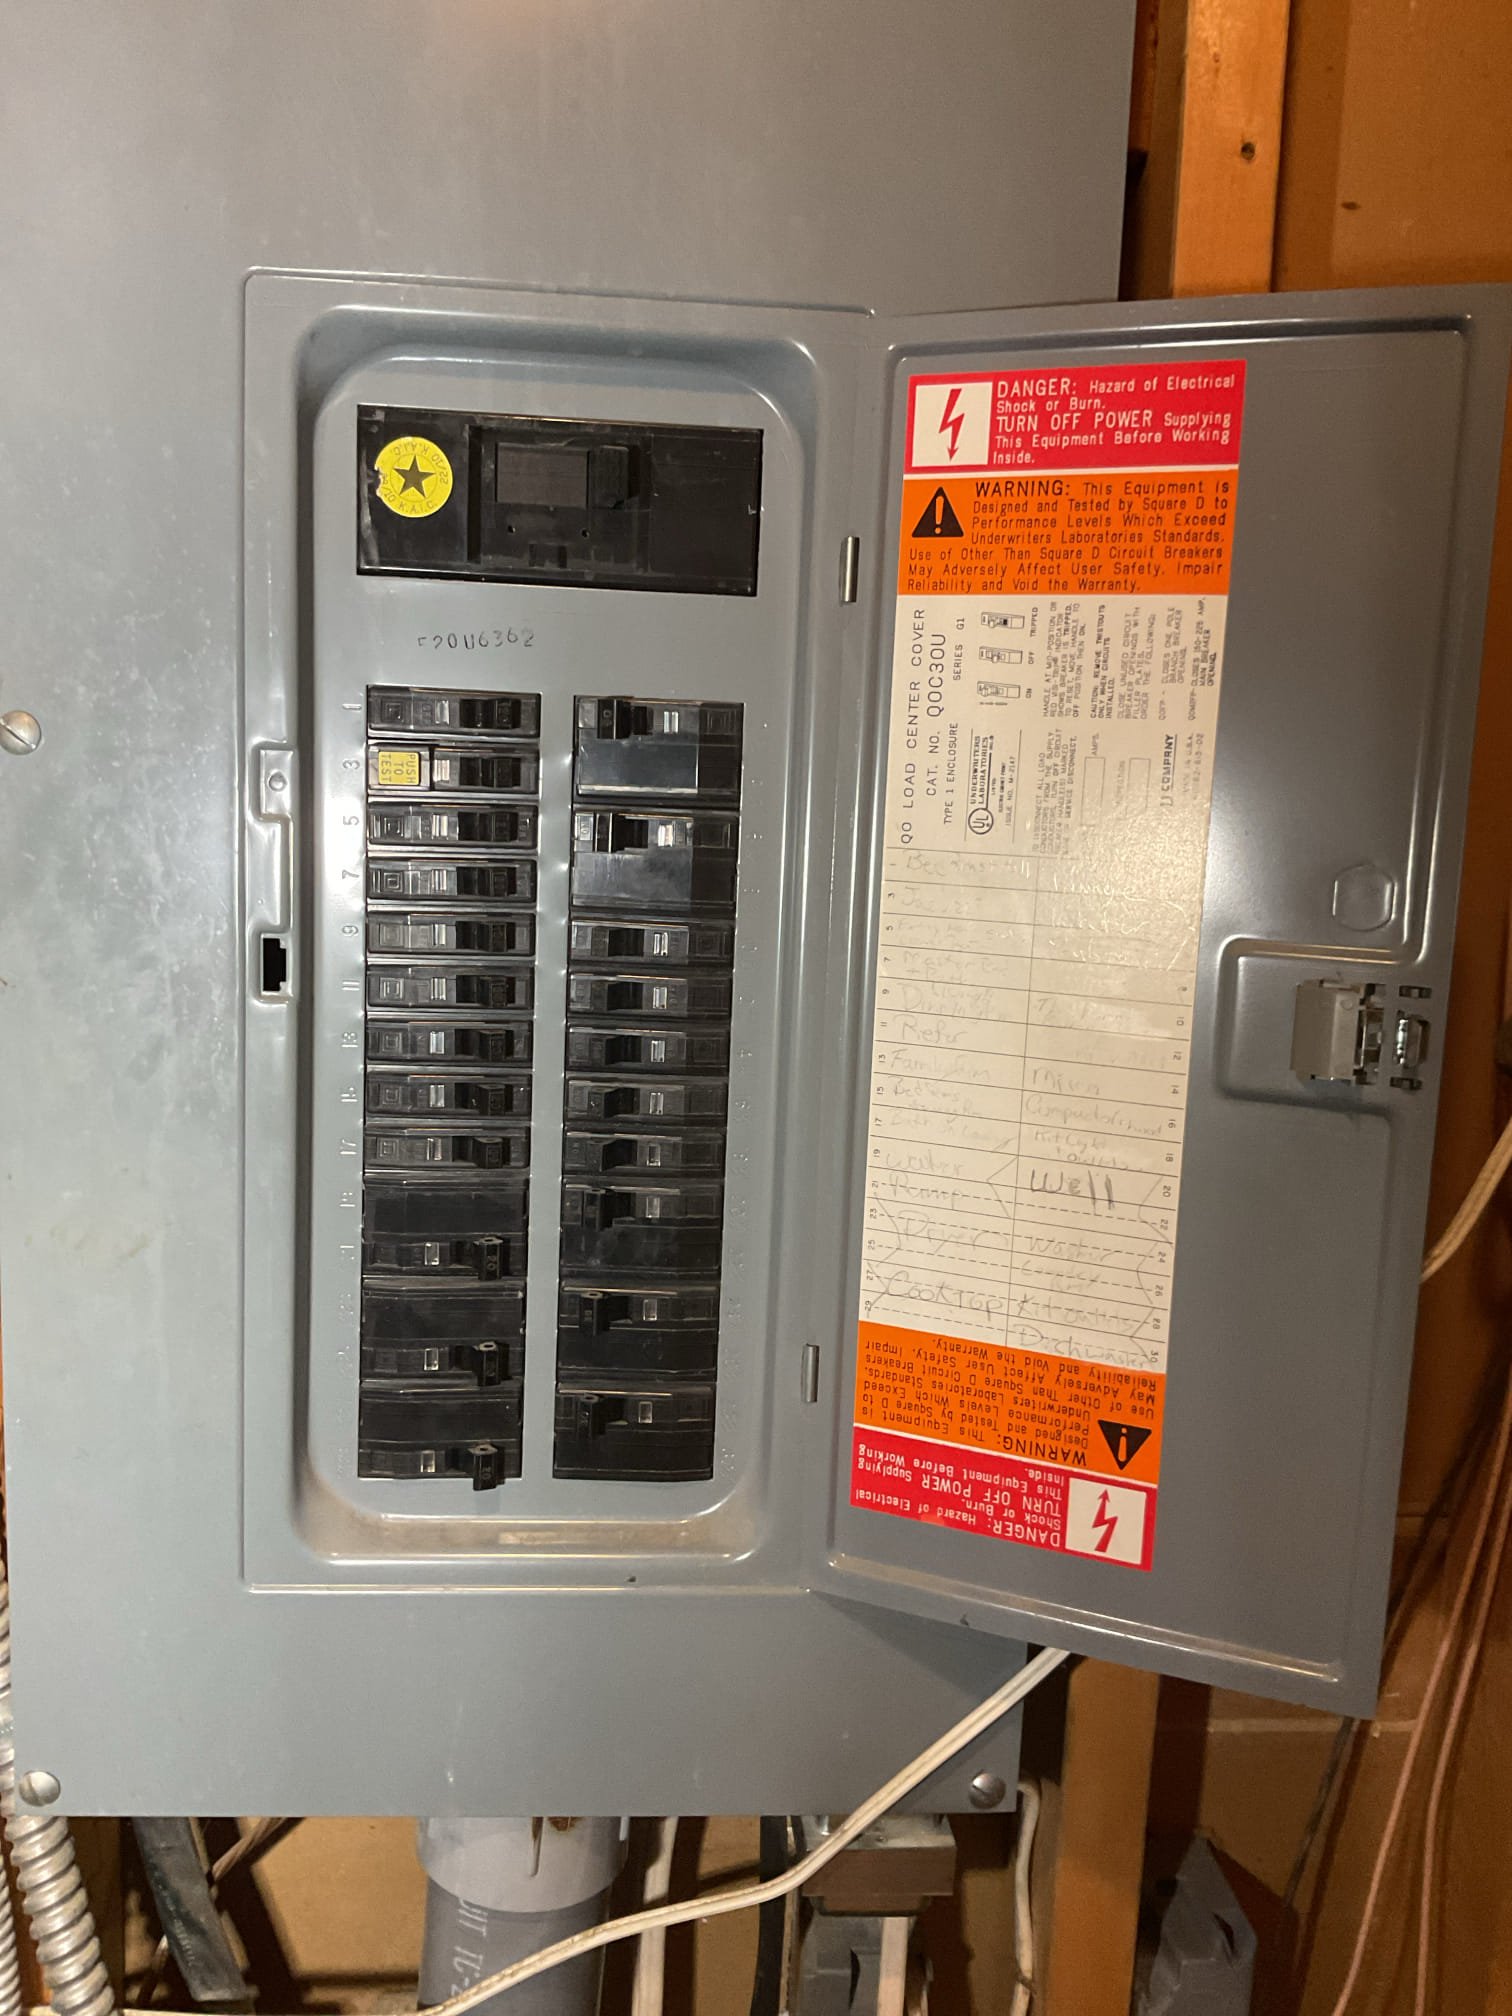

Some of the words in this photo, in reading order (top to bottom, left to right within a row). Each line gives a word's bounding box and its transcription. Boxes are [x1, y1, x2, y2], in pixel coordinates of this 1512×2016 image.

[997, 377, 1076, 398] DANGER:
[1089, 378, 1135, 393] Hazard
[1143, 376, 1158, 391] of
[1166, 373, 1235, 390] Electrical
[996, 399, 1036, 413] Shock
[1045, 399, 1059, 411] or
[1069, 396, 1105, 410] Burn.
[996, 414, 1038, 433] TURN
[1050, 412, 1081, 430] OFF
[1094, 409, 1152, 429] POWER
[1163, 411, 1231, 430] Supplying
[995, 435, 1022, 448] This
[1031, 432, 1103, 450] Equipment
[1114, 431, 1162, 444] Before
[1172, 429, 1230, 445] Working
[993, 451, 1035, 464] Inside.
[975, 479, 1070, 498] WARNING:
[1082, 481, 1112, 496] This
[1123, 479, 1203, 500] Equipment
[1215, 480, 1229, 494] is
[972, 500, 1028, 518] Designed
[1036, 499, 1058, 513] and
[1067, 498, 1110, 512] Tested
[1118, 498, 1133, 515] by
[1142, 497, 1186, 515] Square
[1195, 496, 1204, 510] D
[1214, 496, 1228, 510] to
[971, 516, 1057, 529] Performance
[1067, 515, 1111, 528] Levels
[1122, 514, 1163, 527] Which
[1174, 513, 1227, 526] Exceed
[971, 531, 1051, 545] Underwriters
[1061, 530, 1143, 544] Laboratories
[1152, 529, 1224, 543] Standards.
[909, 548, 931, 561] Use
[940, 548, 952, 560] of
[960, 547, 993, 561] Other
[1003, 547, 1030, 560] Than
[1039, 547, 1082, 564] Square
[1091, 546, 1100, 560] D
[1108, 545, 1154, 559] Circuit
[1164, 545, 1222, 559] Breakers
[907, 564, 933, 580] May
[942, 563, 1007, 580] Adversely
[1017, 563, 1061, 575] Affect
[1071, 562, 1103, 575] User
[1177, 562, 1223, 576] Impair
[907, 579, 972, 594] Reliability
[981, 579, 1003, 591] and
[1012, 579, 1039, 591] Void
[1048, 579, 1068, 591] the
[1078, 578, 1140, 593] Warranty.
[955, 617, 965, 630] G1
[1029, 606, 1038, 637] TRIPPED
[910, 609, 925, 666] COVER
[952, 644, 963, 680] SERIES
[906, 681, 920, 749] CENTER
[927, 731, 940, 754] NO.
[946, 723, 958, 782] ENCLOSURE
[343, 760, 361, 770] 3
[381, 754, 392, 784] TEST
[394, 761, 404, 776] TO
[406, 754, 416, 784] PUSH
[970, 735, 980, 804] UNDERWRITERS
[978, 736, 988, 804] LABORATORIES
[902, 763, 916, 808] LOAD
[925, 765, 938, 796] CAT.
[343, 815, 361, 826] 5
[943, 801, 953, 824] TYPE
[900, 822, 913, 844] QO
[342, 869, 361, 880] 7
[865, 1340, 902, 1358] Impair
[932, 1337, 988, 1360] Warranty.
[996, 1351, 1015, 1365] the
[865, 1354, 914, 1374] Breakers
[922, 1364, 961, 1383] Circuit
[965, 1359, 994, 1375] User
[1024, 1356, 1049, 1372] Void
[1058, 1362, 1080, 1375] and
[864, 1366, 923, 1389] Standards.
[969, 1374, 976, 1386] D
[984, 1372, 1023, 1395] Square
[1003, 1366, 1045, 1384] Affect
[1054, 1371, 1120, 1398] Adversely
[1088, 1365, 1156, 1390] Reliability
[863, 1380, 906, 1399] Exceed
[915, 1390, 949, 1408] Which
[931, 1380, 1004, 1404] Laboratories
[1032, 1386, 1058, 1402] Than
[1129, 1384, 1155, 1405] May
[862, 1393, 874, 1406] to
[881, 1397, 888, 1409] D
[896, 1396, 933, 1418] Square
[959, 1399, 999, 1417] Levels
[1013, 1396, 1090, 1420] Underwriters
[1067, 1392, 1101, 1409] Other
[1109, 1401, 1122, 1412] of
[861, 1406, 873, 1418] is
[882, 1406, 949, 1435] Equipment
[941, 1404, 953, 1422] by
[1130, 1404, 1154, 1419] Use
[960, 1413, 999, 1431] Tested
[1007, 1422, 1027, 1435] and
[1008, 1409, 1089, 1435] Performance
[959, 1426, 984, 1442] This
[1035, 1423, 1088, 1448] Designed
[858, 1443, 905, 1467] Working
[997, 1433, 1086, 1466] WARNING:
[857, 1457, 912, 1482] Supplying
[913, 1458, 954, 1477] Before
[921, 1473, 971, 1498] POWER
[962, 1468, 1028, 1493] Equipment
[1024, 1468, 1064, 1487] Inside.
[855, 1489, 910, 1511] Electrical
[983, 1487, 1011, 1506] OFF
[1037, 1484, 1062, 1500] This
[918, 1503, 929, 1513] of
[936, 1506, 976, 1525] Hazard
[961, 1498, 994, 1516] Burn.
[1002, 1507, 1015, 1518] or
[1022, 1495, 1061, 1517] TURN
[1024, 1512, 1061, 1530] Shock
[987, 1517, 1060, 1547] DANGER:
